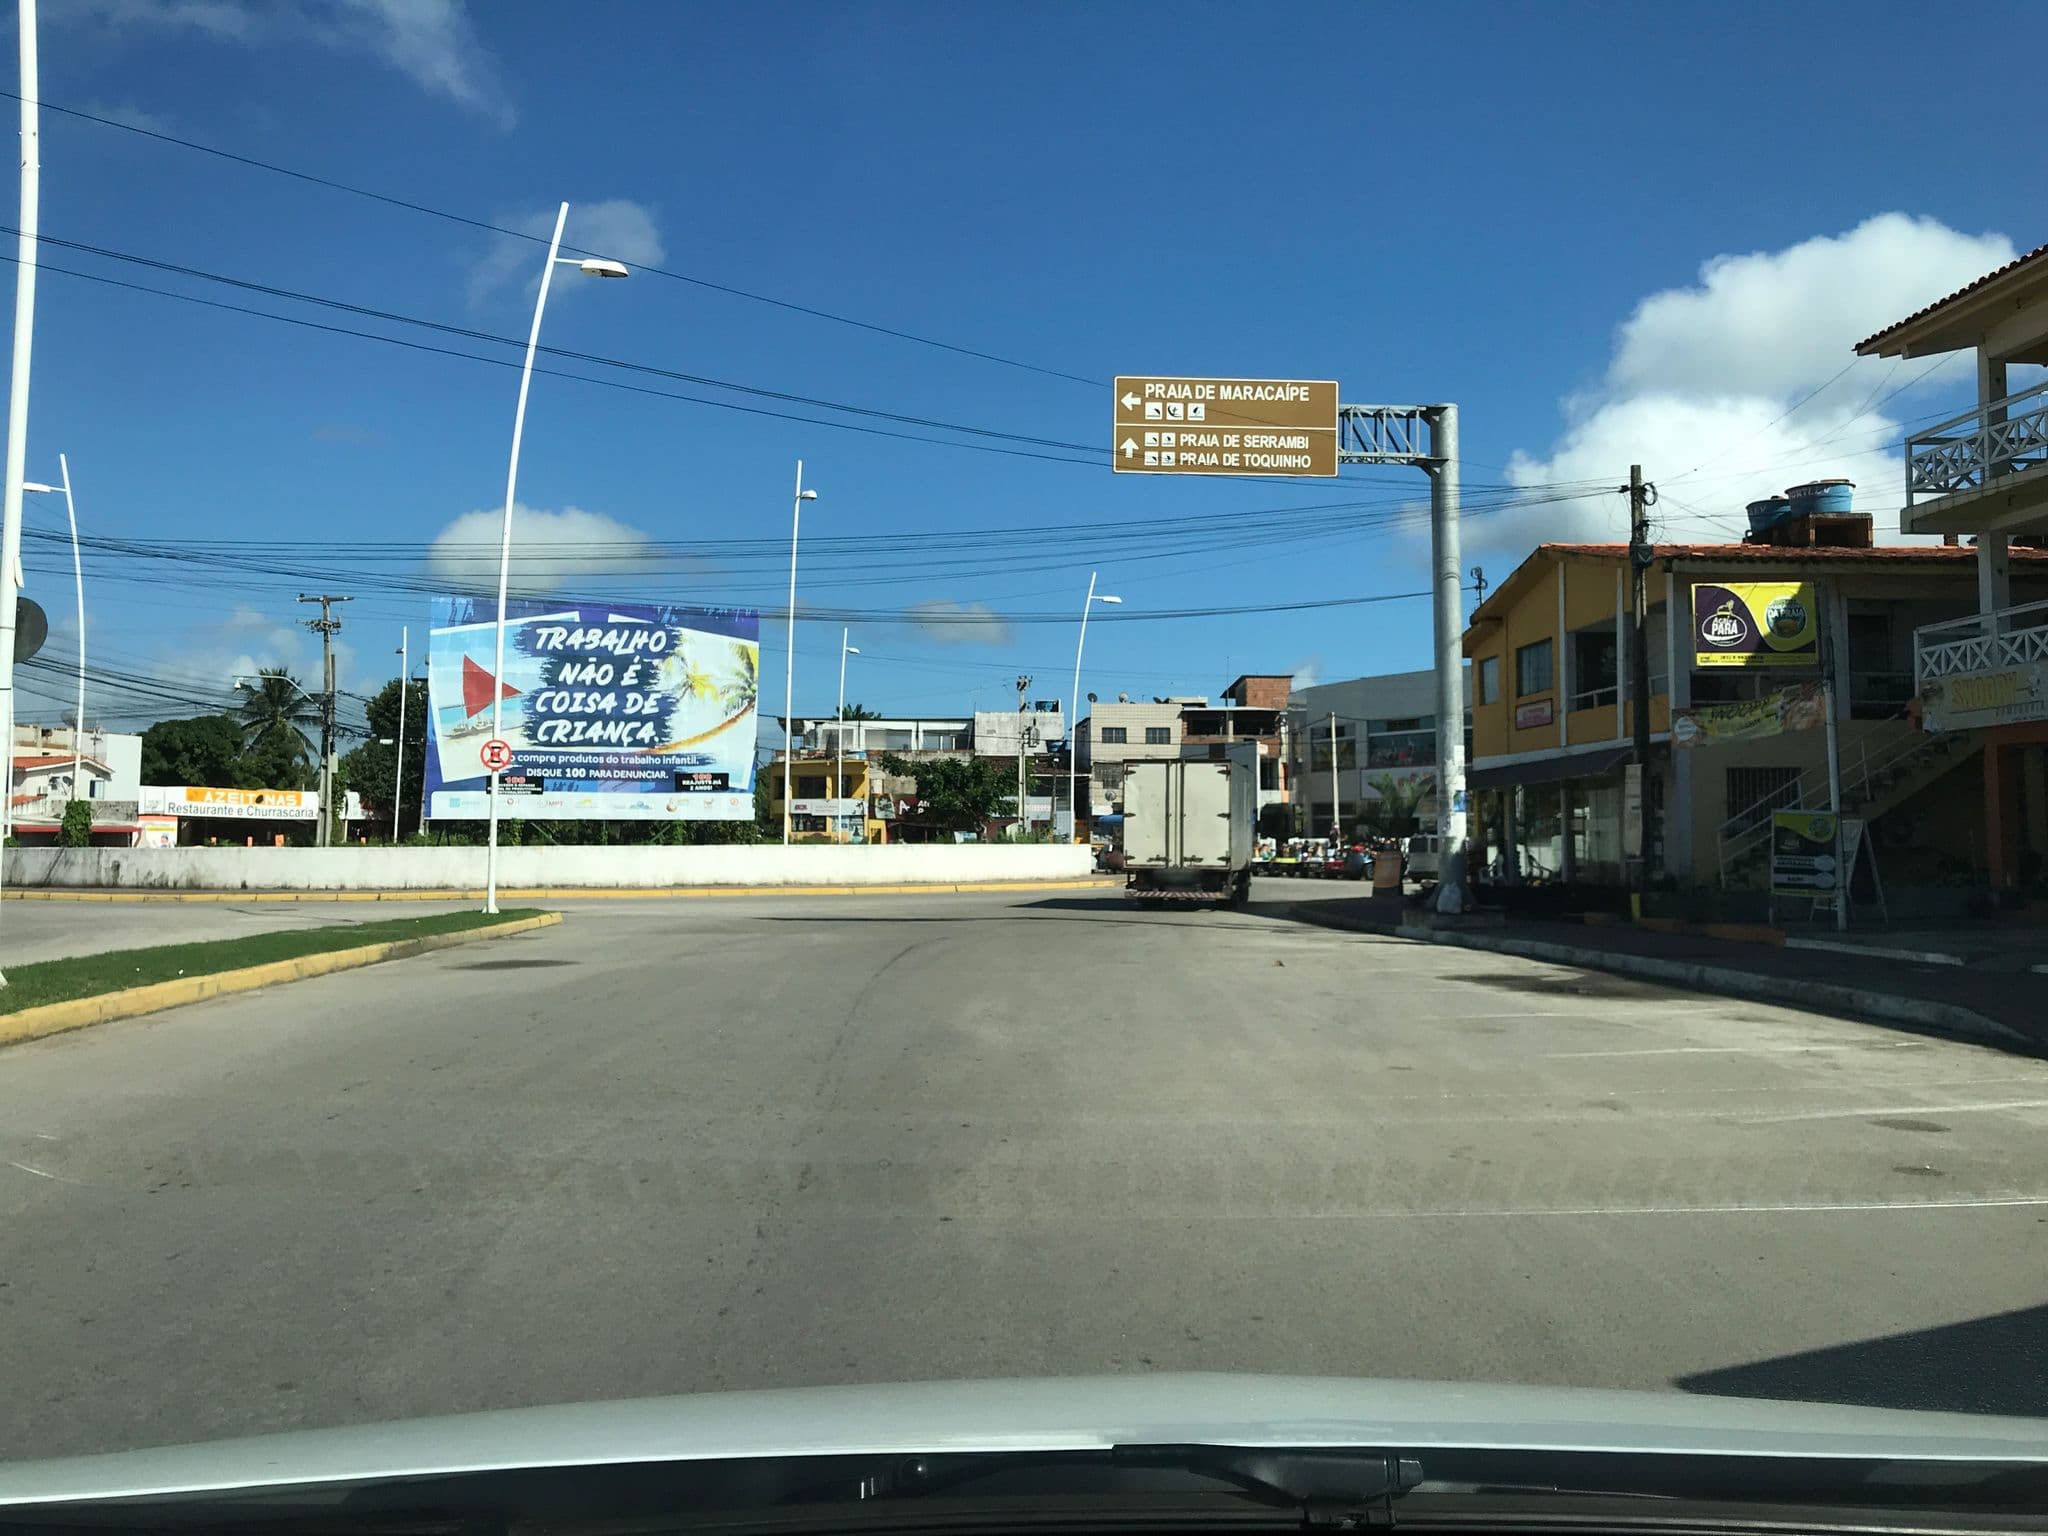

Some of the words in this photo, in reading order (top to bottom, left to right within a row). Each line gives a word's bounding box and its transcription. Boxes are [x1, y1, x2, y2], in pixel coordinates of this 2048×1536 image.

[1145, 383, 1193, 399] PRAIA
[1195, 384, 1216, 400] DE
[1220, 382, 1310, 402] MARACAÍPE
[1180, 433, 1220, 448] PRAIA
[1223, 434, 1240, 448] DE
[1243, 435, 1309, 450] SERRAMBI
[1179, 452, 1219, 466] PRAIA
[1223, 453, 1240, 467] DE
[1243, 453, 1311, 468] TOQUINHO
[1711, 619, 1738, 636] PARÁ
[535, 626, 667, 656] TRABALHO
[558, 657, 614, 686] NÃO
[620, 655, 642, 687] É
[535, 691, 618, 715] COISA
[622, 692, 662, 715] DE
[537, 719, 660, 747] CRIANÇA.
[517, 754, 557, 765] compre
[558, 754, 604, 764] produtos
[606, 755, 619, 765] do
[620, 755, 661, 765] trabalho
[662, 755, 700, 765] infantil.
[526, 768, 563, 778] DISQUE
[565, 767, 586, 778] 100
[589, 769, 612, 778] PARA
[613, 769, 669, 779] DENUNCIAR.
[168, 802, 234, 816] Restaurante
[237, 808, 244, 816] e
[246, 805, 314, 818] Churrascaria
